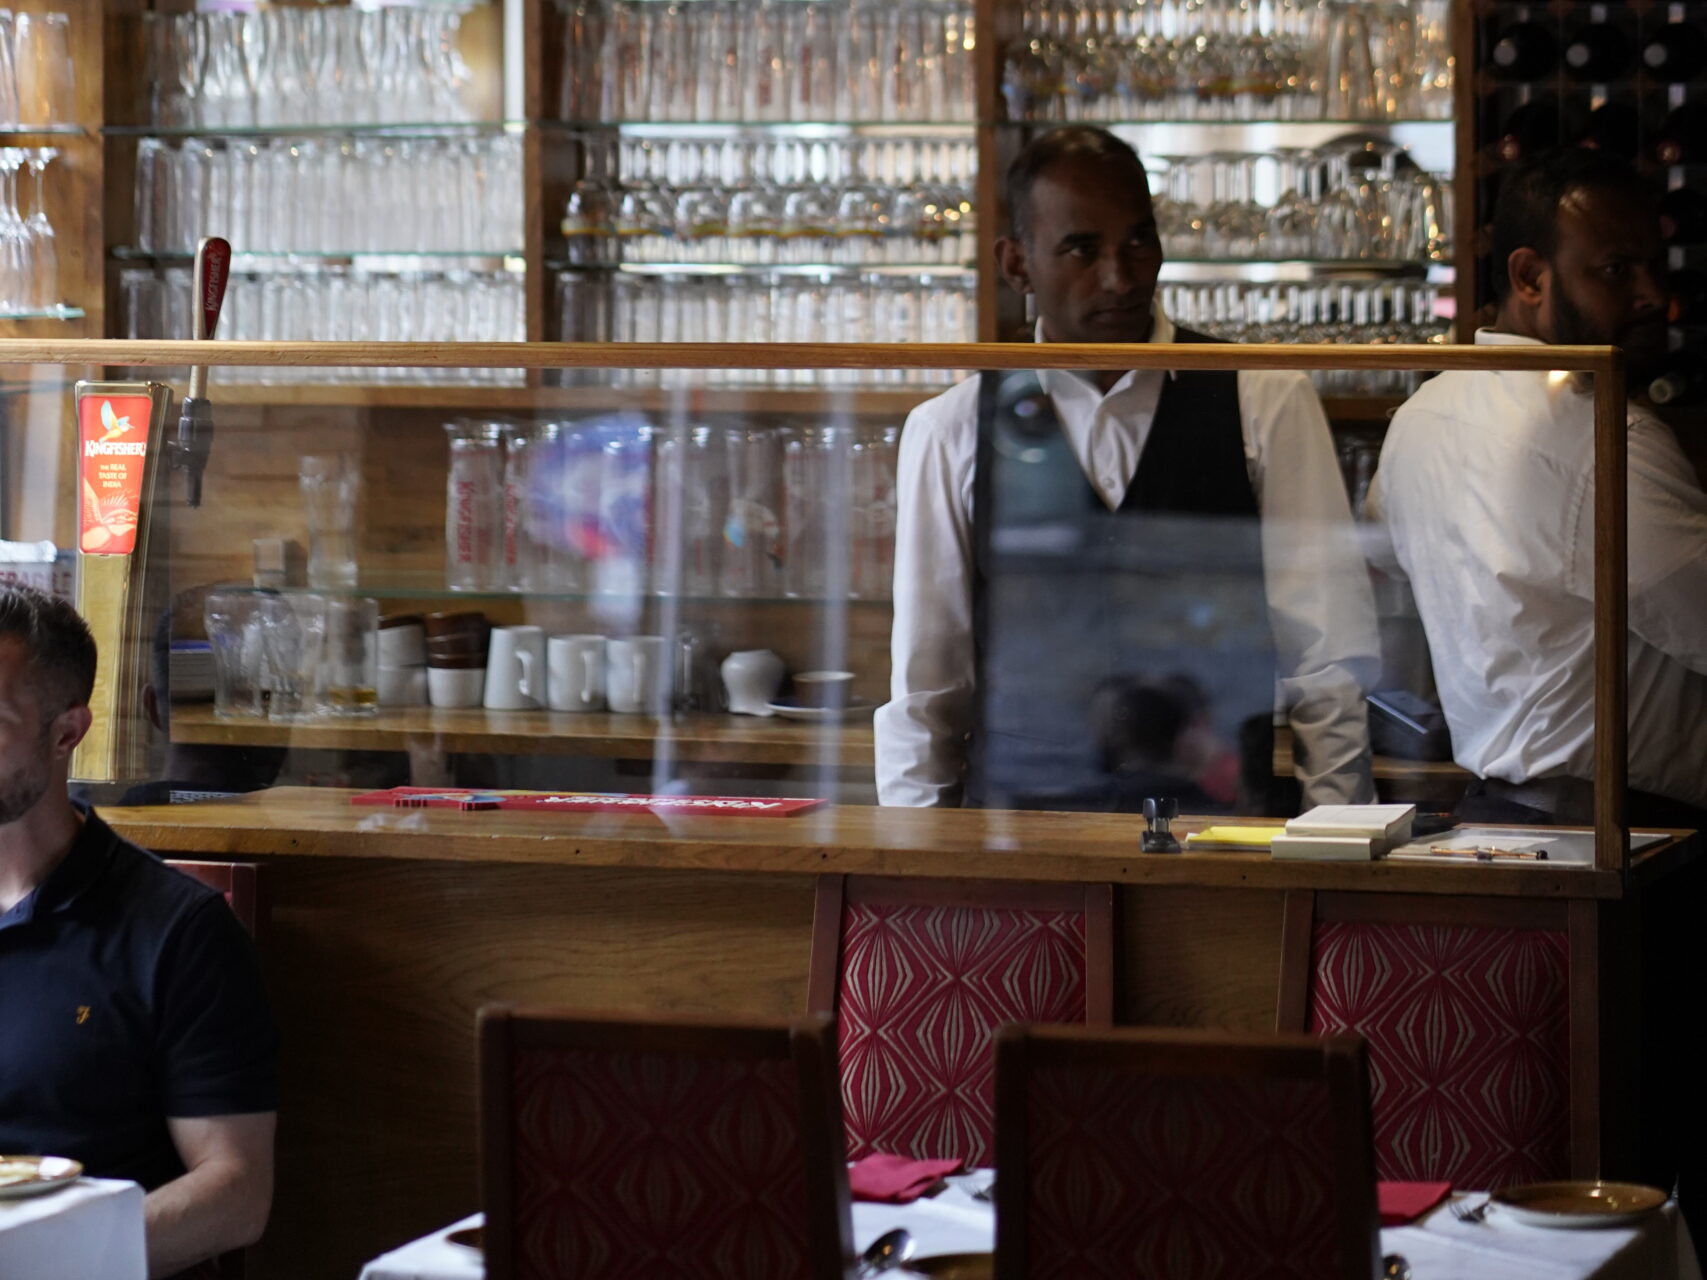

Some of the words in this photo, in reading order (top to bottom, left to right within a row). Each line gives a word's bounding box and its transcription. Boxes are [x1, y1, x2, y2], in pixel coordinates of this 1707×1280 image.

[85, 440, 146, 457] KINGFISHER
[98, 472, 117, 480] TASTE
[118, 472, 128, 480] OF
